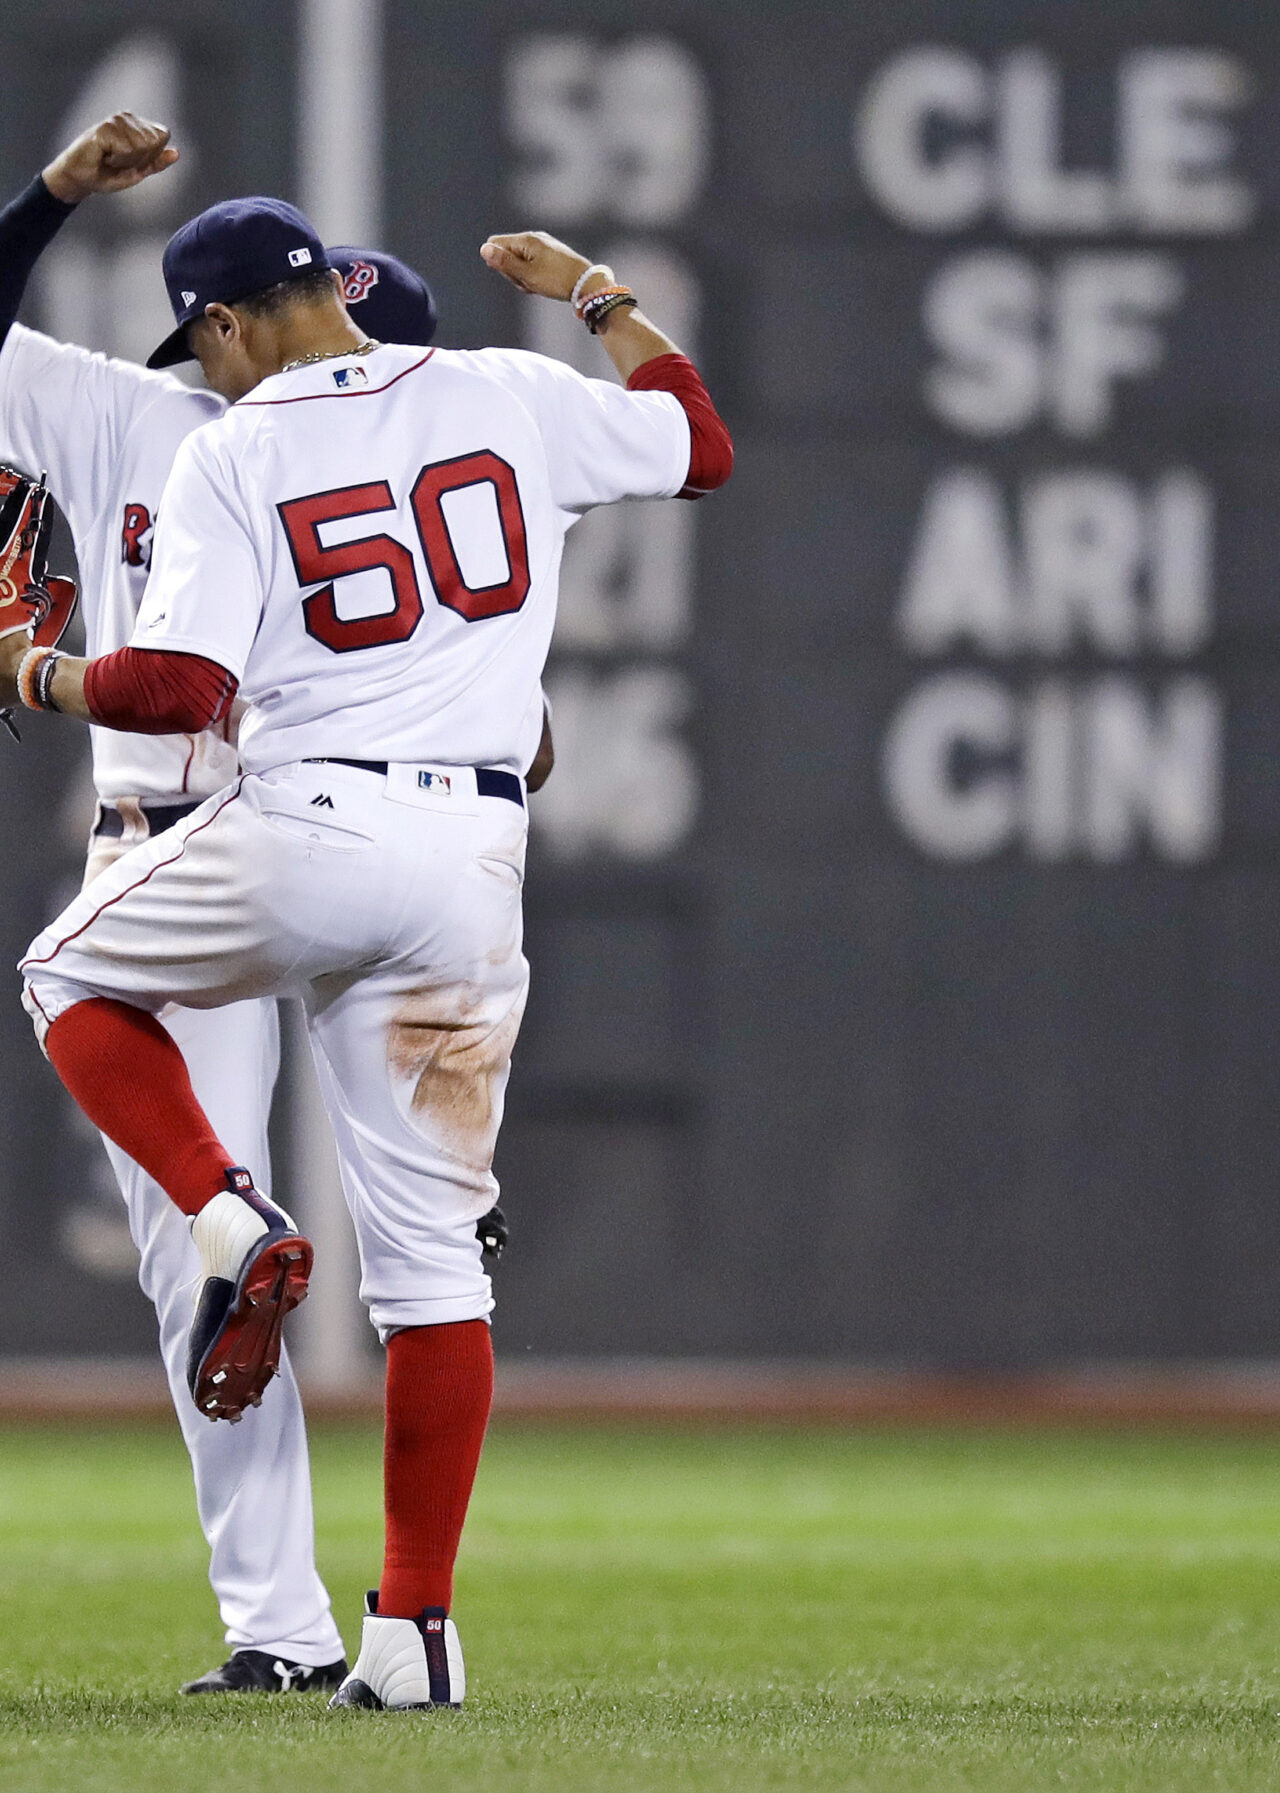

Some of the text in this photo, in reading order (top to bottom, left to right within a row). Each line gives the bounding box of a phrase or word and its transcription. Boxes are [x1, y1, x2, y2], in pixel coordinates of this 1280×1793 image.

[505, 32, 708, 228] 59
[856, 43, 1258, 233] CLE
[923, 249, 1186, 439] SF
[276, 448, 533, 653] 50
[898, 464, 1212, 657] ARI
[885, 671, 1223, 865] CIN
[235, 1174, 250, 1187] 50
[426, 1620, 441, 1631] 50
